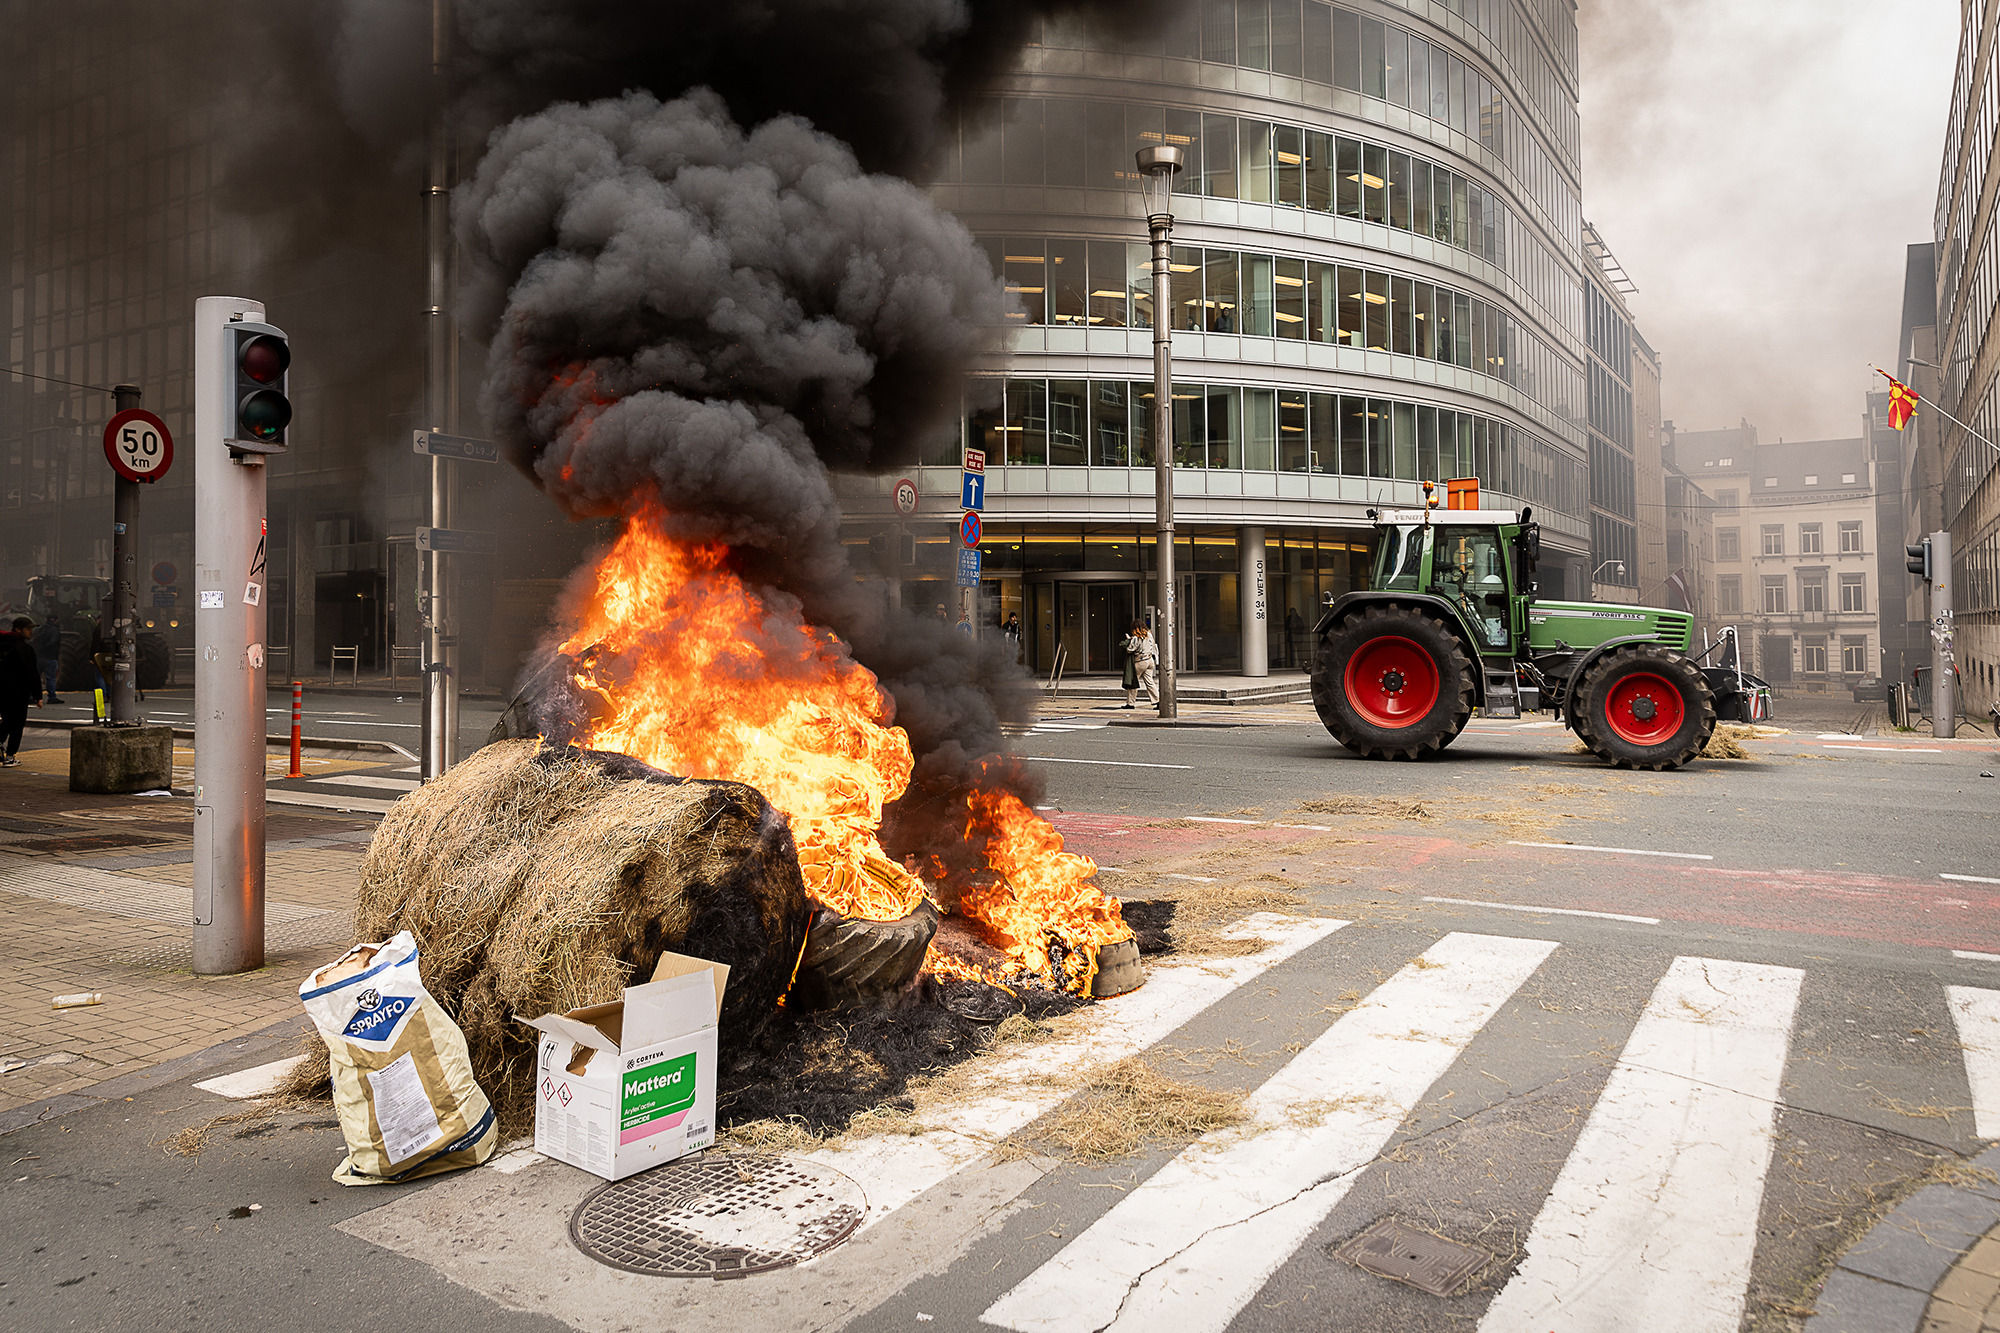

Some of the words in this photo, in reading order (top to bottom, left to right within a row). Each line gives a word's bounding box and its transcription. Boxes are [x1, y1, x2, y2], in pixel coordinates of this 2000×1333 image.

[122, 428, 158, 456] 50
[131, 455, 150, 468] km
[899, 489, 914, 504] 50
[1256, 560, 1264, 597] WET-LOI
[1255, 600, 1265, 608] 34
[1256, 611, 1265, 620] 36
[349, 999, 405, 1036] SPRAYFO
[636, 1050, 664, 1064] CORTEVA
[623, 1114, 651, 1128] HERBICIDE
